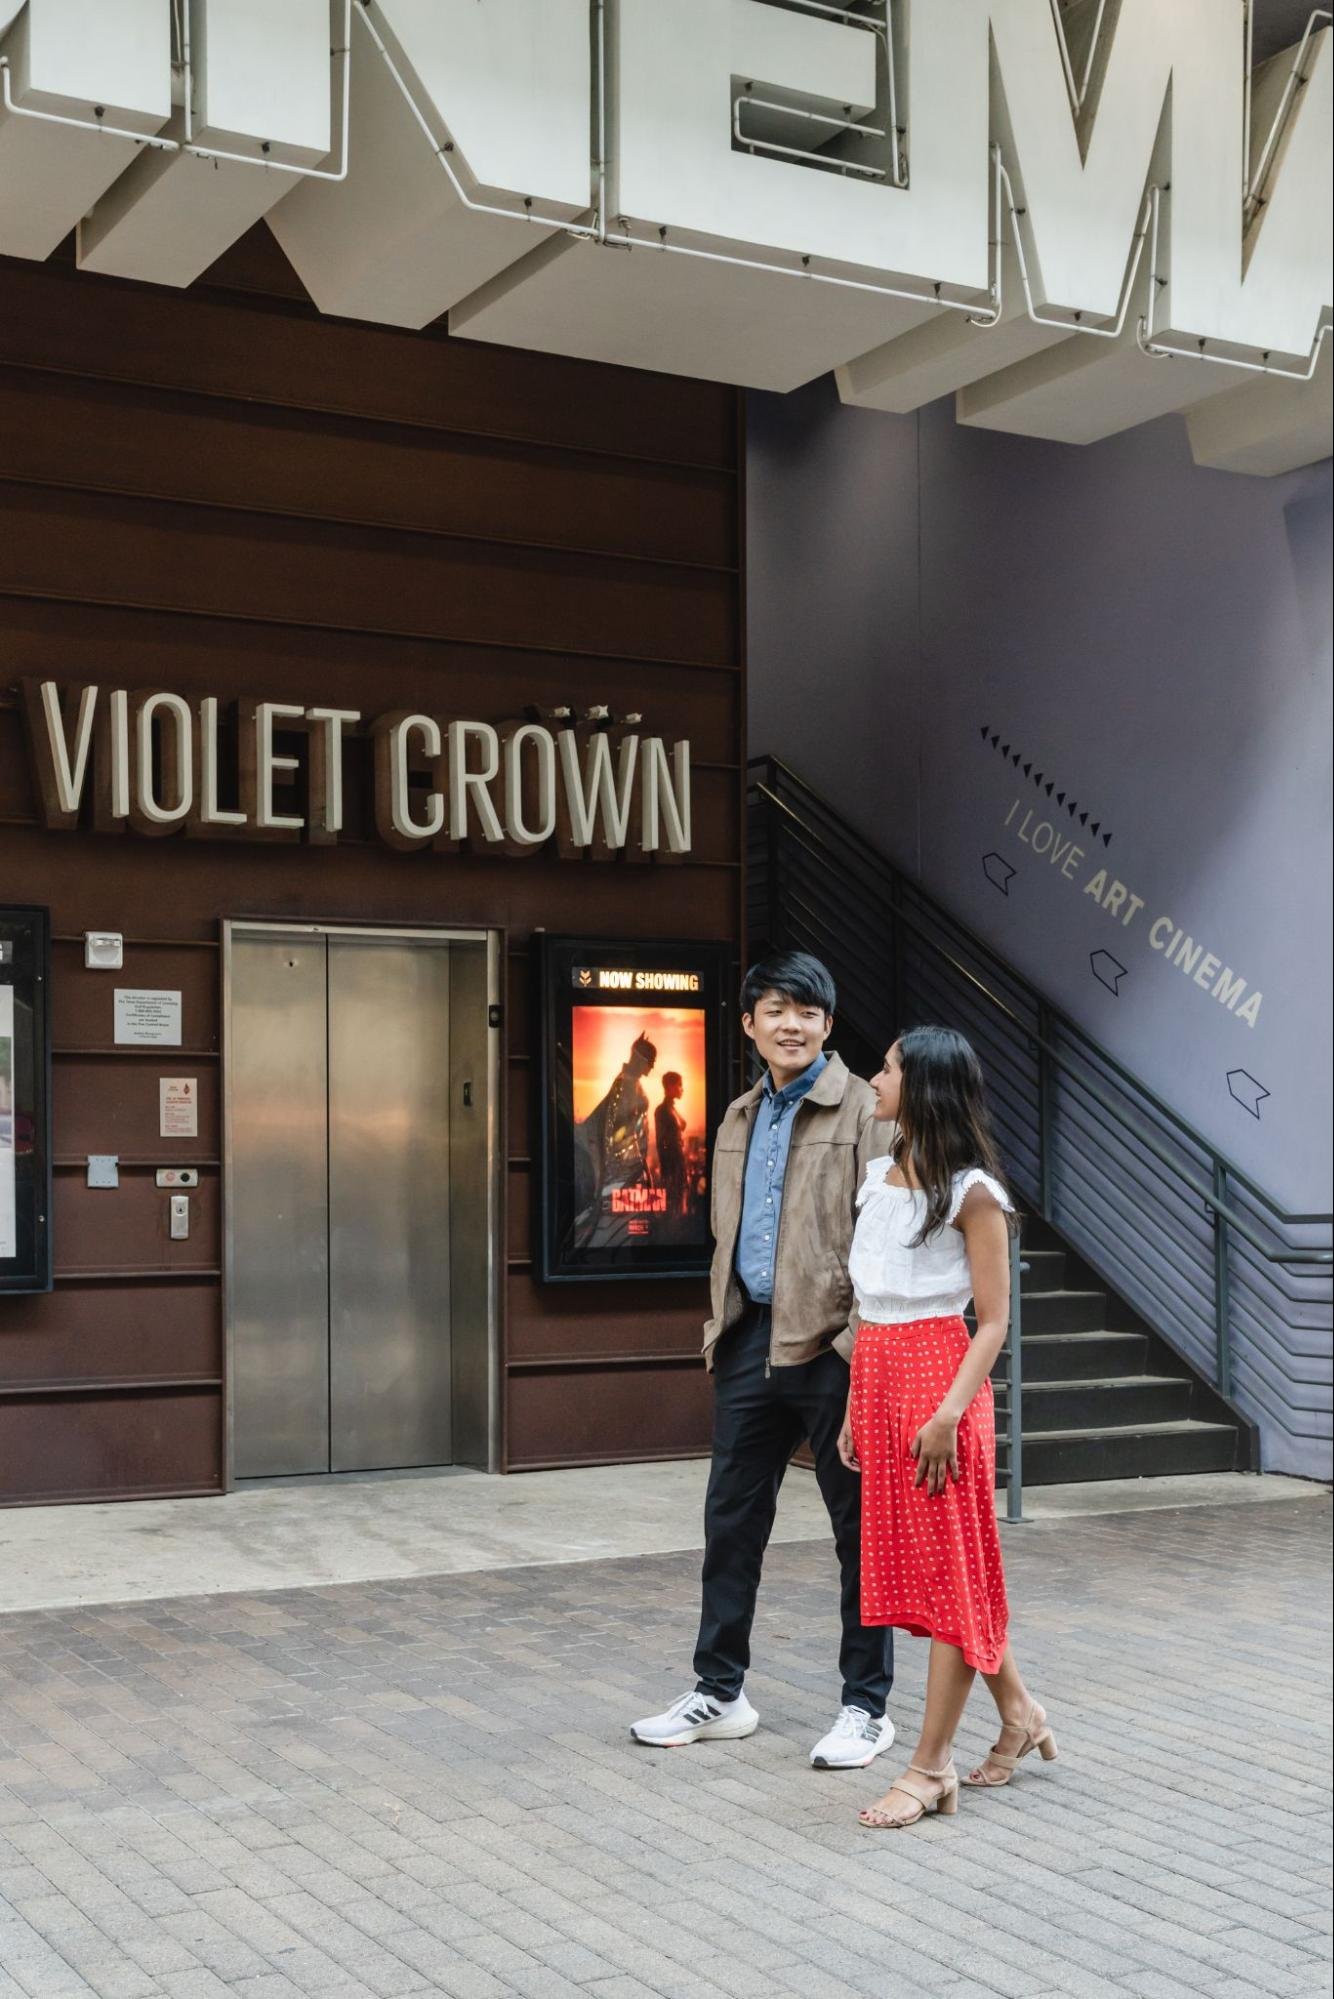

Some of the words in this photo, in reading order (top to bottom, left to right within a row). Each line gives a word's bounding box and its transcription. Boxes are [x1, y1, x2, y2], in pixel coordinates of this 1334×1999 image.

[41, 681, 361, 832] VIOLET
[391, 714, 691, 853] CROWN
[599, 970, 633, 989] NOW
[635, 972, 699, 991] SHOWING
[1004, 799, 1021, 826] I
[1017, 808, 1085, 880] LOVE
[1084, 869, 1145, 926] ART
[1149, 916, 1264, 1029] CINEMA
